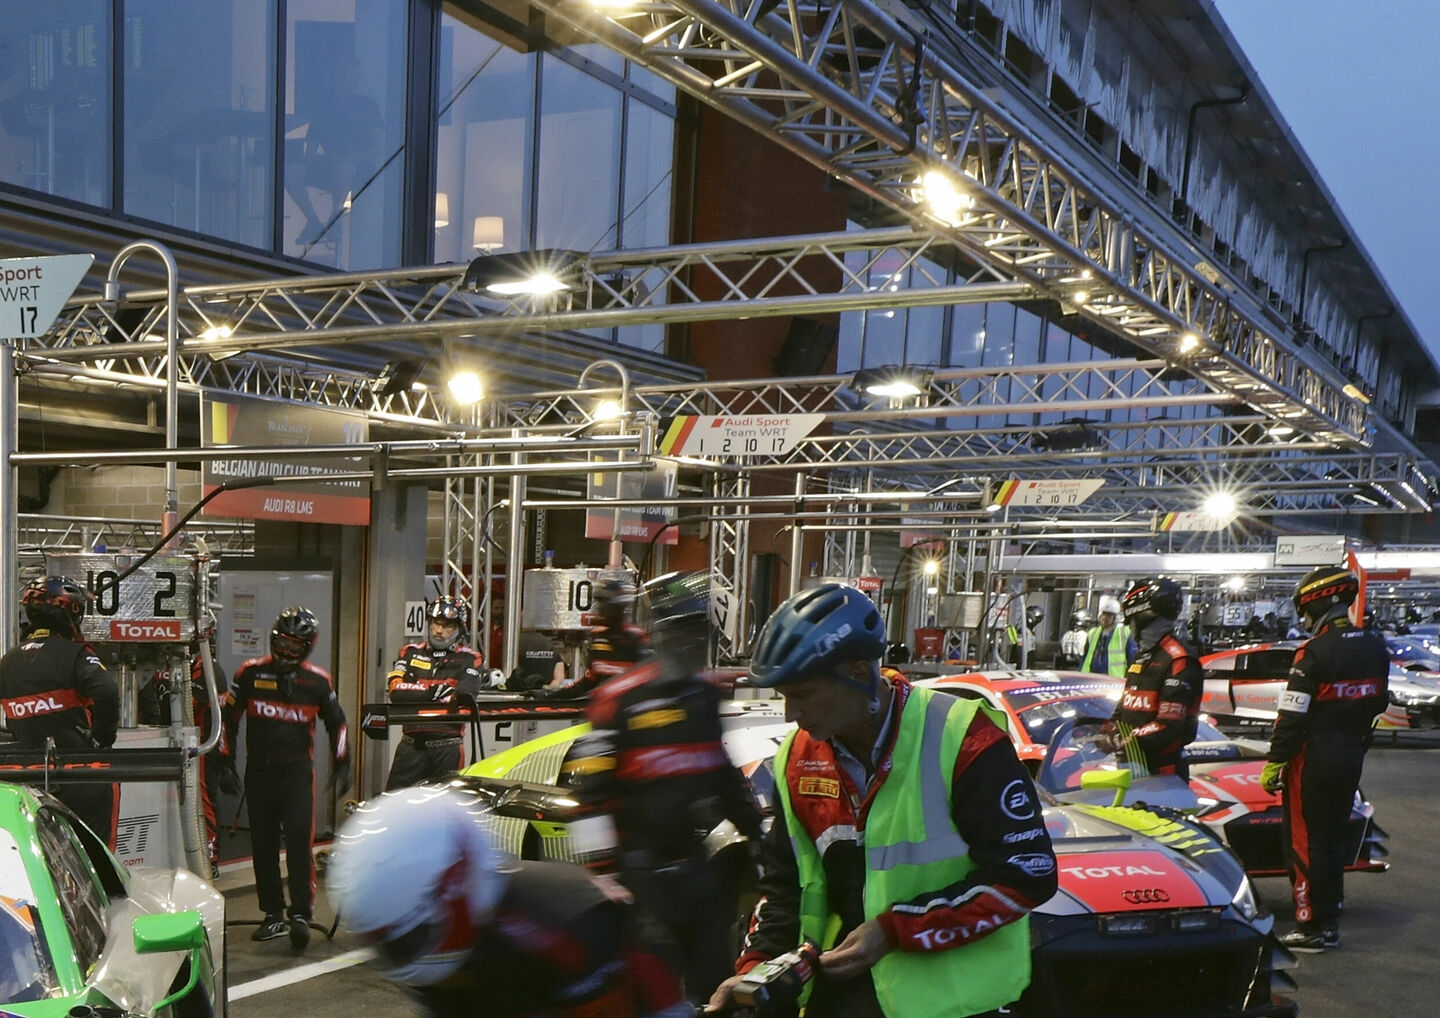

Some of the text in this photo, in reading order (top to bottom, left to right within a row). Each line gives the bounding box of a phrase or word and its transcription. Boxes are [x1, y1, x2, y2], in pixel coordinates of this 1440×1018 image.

[0, 285, 40, 303] WRT
[20, 307, 38, 333] 17
[725, 417, 790, 428] Audi Sport
[725, 427, 788, 437] Team WRT
[723, 438, 731, 452] 2
[745, 438, 757, 452] 10
[772, 438, 785, 452] 17
[211, 459, 257, 477] BELGIAN
[263, 498, 313, 515] AUDI R8 LMS
[1035, 494, 1042, 504] 2
[1051, 494, 1060, 504] 10
[1068, 494, 1078, 504] 17
[154, 571, 176, 617] 2
[568, 580, 593, 611] 10
[407, 606, 424, 632] 40
[116, 623, 176, 637] TOTAL
[9, 697, 63, 716] TOTAL
[1124, 691, 1151, 709] OTAL
[254, 701, 308, 721] TOTAL
[1062, 865, 1166, 880] TOTAL
[913, 914, 1011, 949] TOTAL
